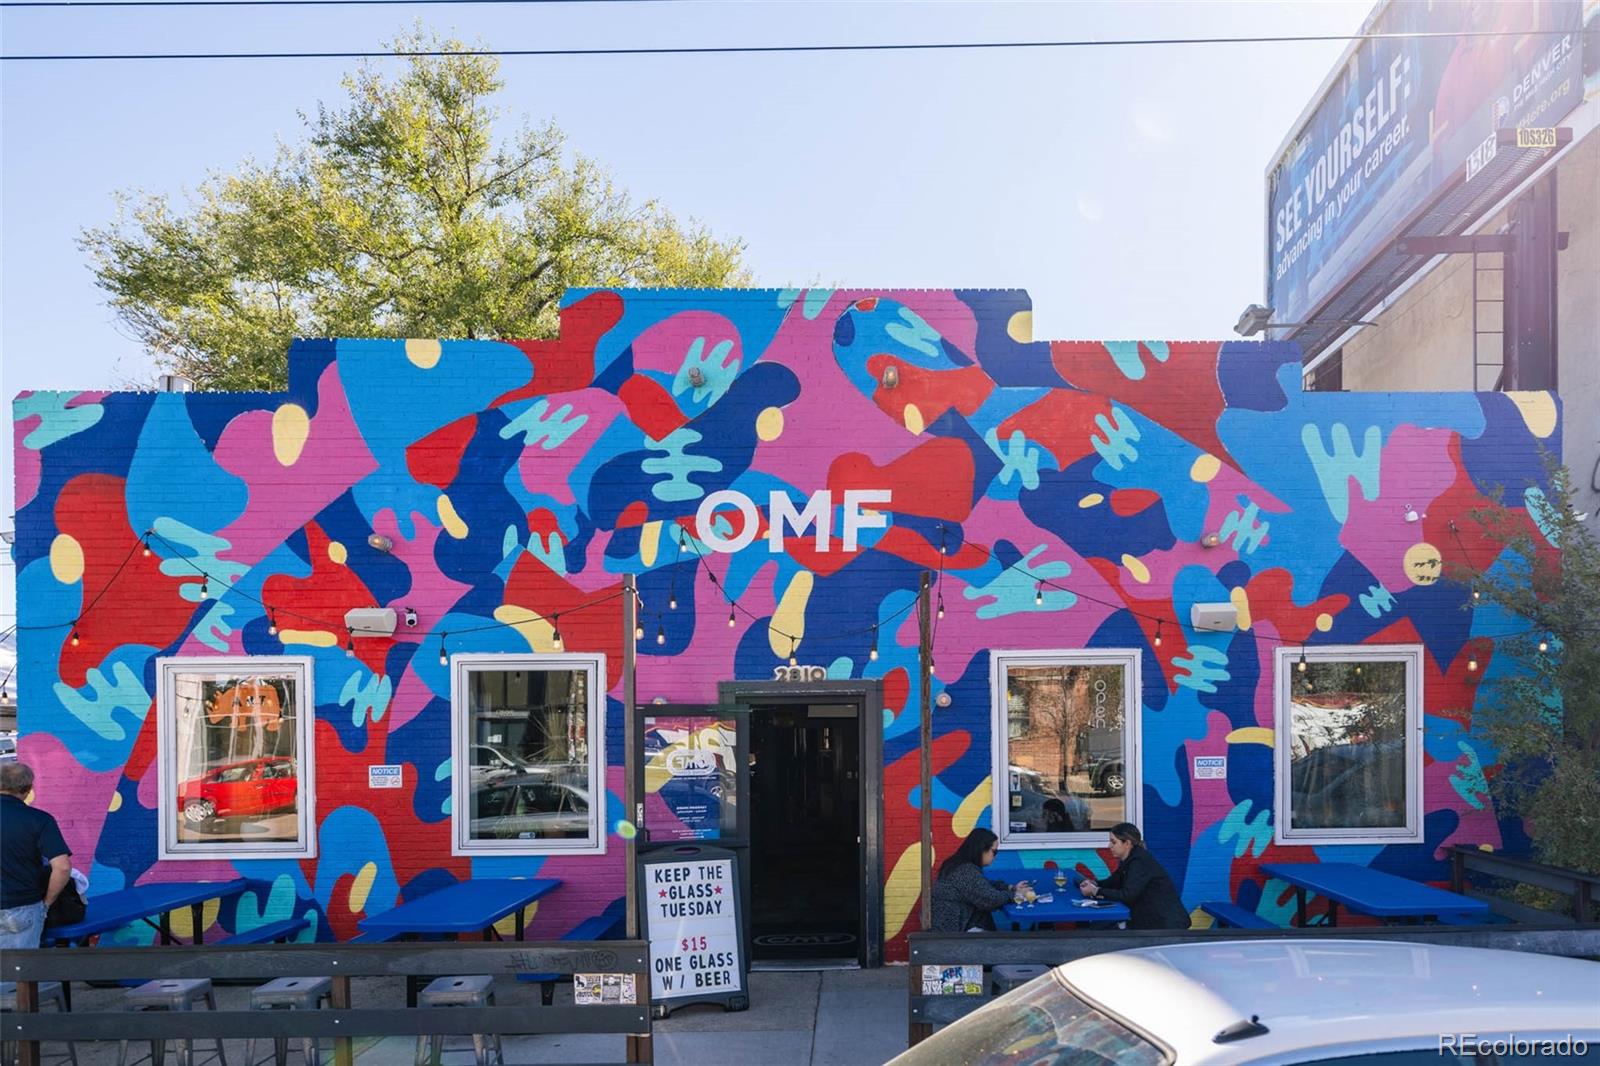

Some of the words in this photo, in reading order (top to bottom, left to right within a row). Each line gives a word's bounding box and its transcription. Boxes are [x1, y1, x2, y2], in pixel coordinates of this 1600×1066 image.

[1512, 33, 1571, 103] DENVER
[1518, 129, 1554, 147] 10S326
[1276, 183, 1303, 253] SEE
[1304, 53, 1411, 217] YOURSELF:
[1276, 211, 1323, 281] advancing
[1324, 198, 1335, 223] in
[1337, 164, 1362, 217] your
[1364, 113, 1410, 179] career.
[695, 489, 892, 554] OMF
[655, 867, 691, 883] KEEP
[698, 865, 723, 880] THE
[669, 883, 713, 900] GLASS
[660, 900, 722, 918] TUESDAY
[682, 936, 707, 951] $15
[655, 956, 682, 973] ONE
[689, 952, 734, 970] GLASS
[695, 970, 731, 987] BEER
